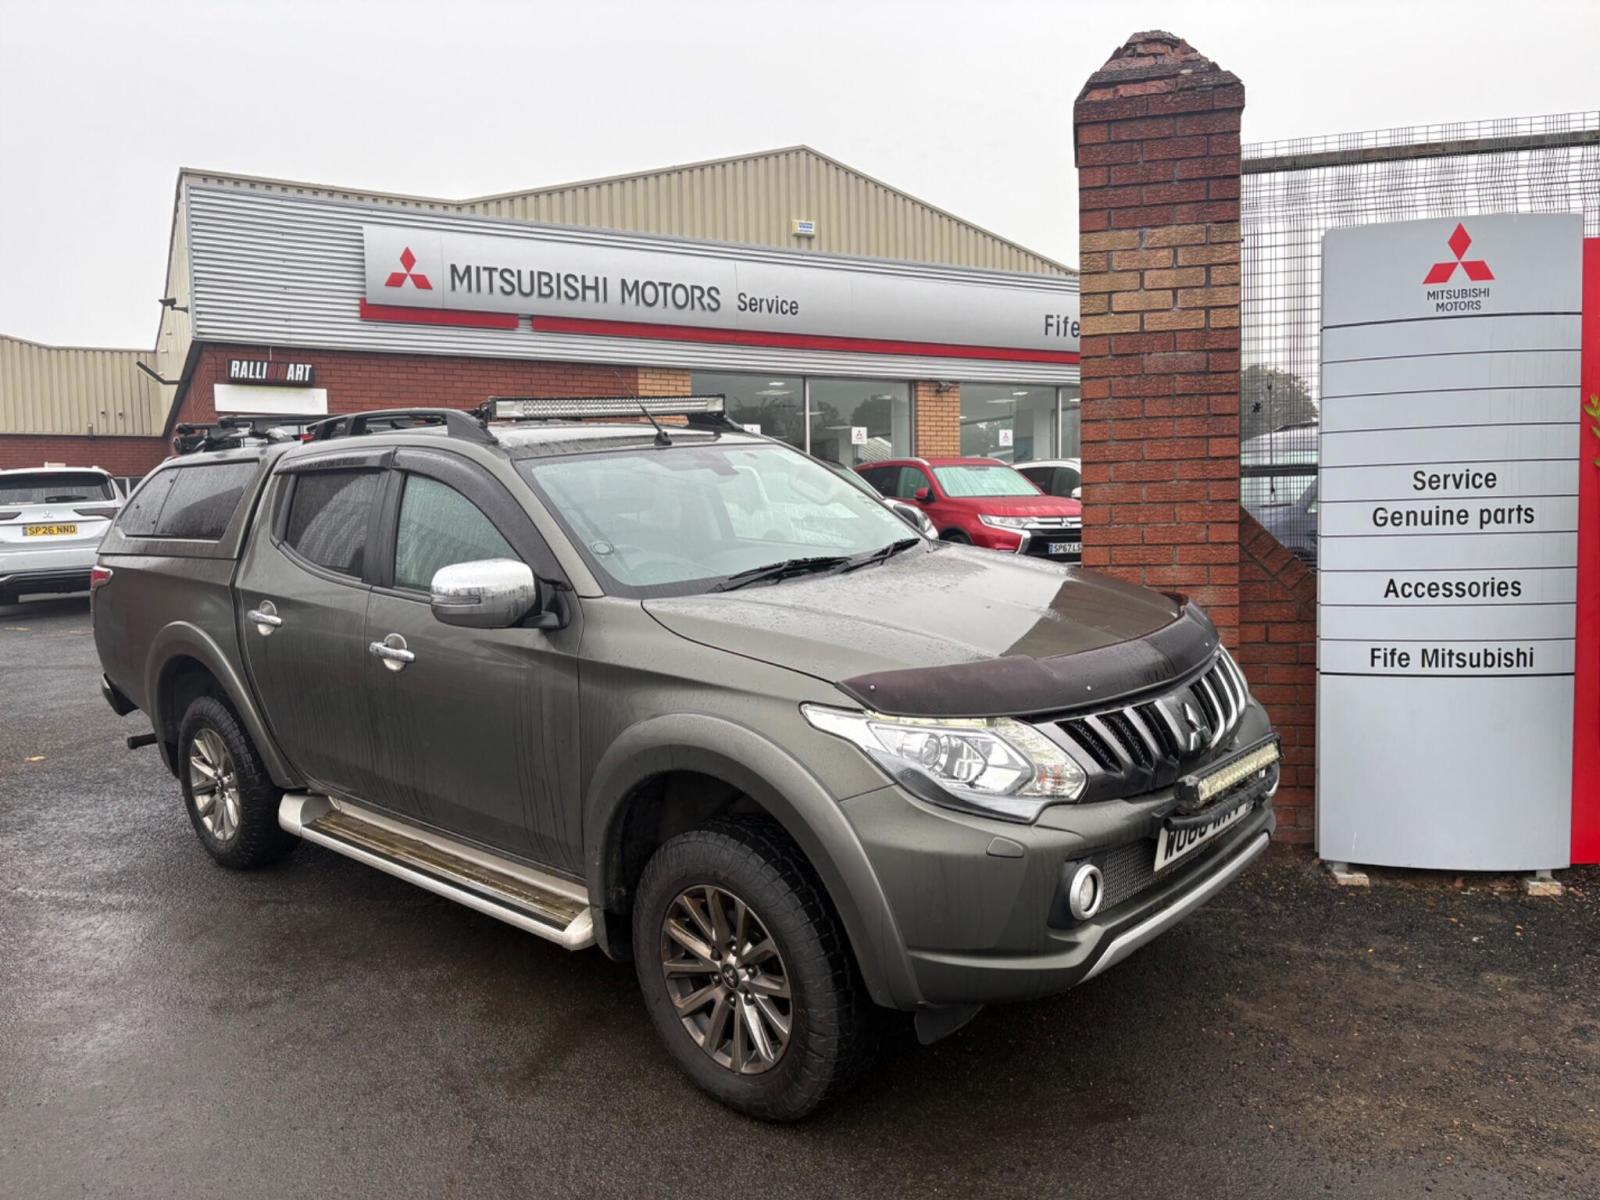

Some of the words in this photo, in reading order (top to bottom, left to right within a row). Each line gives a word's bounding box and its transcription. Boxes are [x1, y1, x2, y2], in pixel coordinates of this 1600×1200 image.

[450, 263, 608, 304] MITSUBISHI
[620, 278, 721, 313] MOTORS
[737, 292, 799, 316] Service
[1426, 287, 1490, 301] MITSUBISHI
[1435, 300, 1482, 313] MOTORS
[1044, 314, 1080, 338] Fife
[1412, 468, 1498, 491] Service
[1372, 505, 1470, 528] Genuine
[1479, 504, 1535, 530] parts
[1384, 576, 1522, 599] Accessories
[1370, 647, 1410, 668] Fife
[1421, 646, 1535, 669] Mitsubishi
